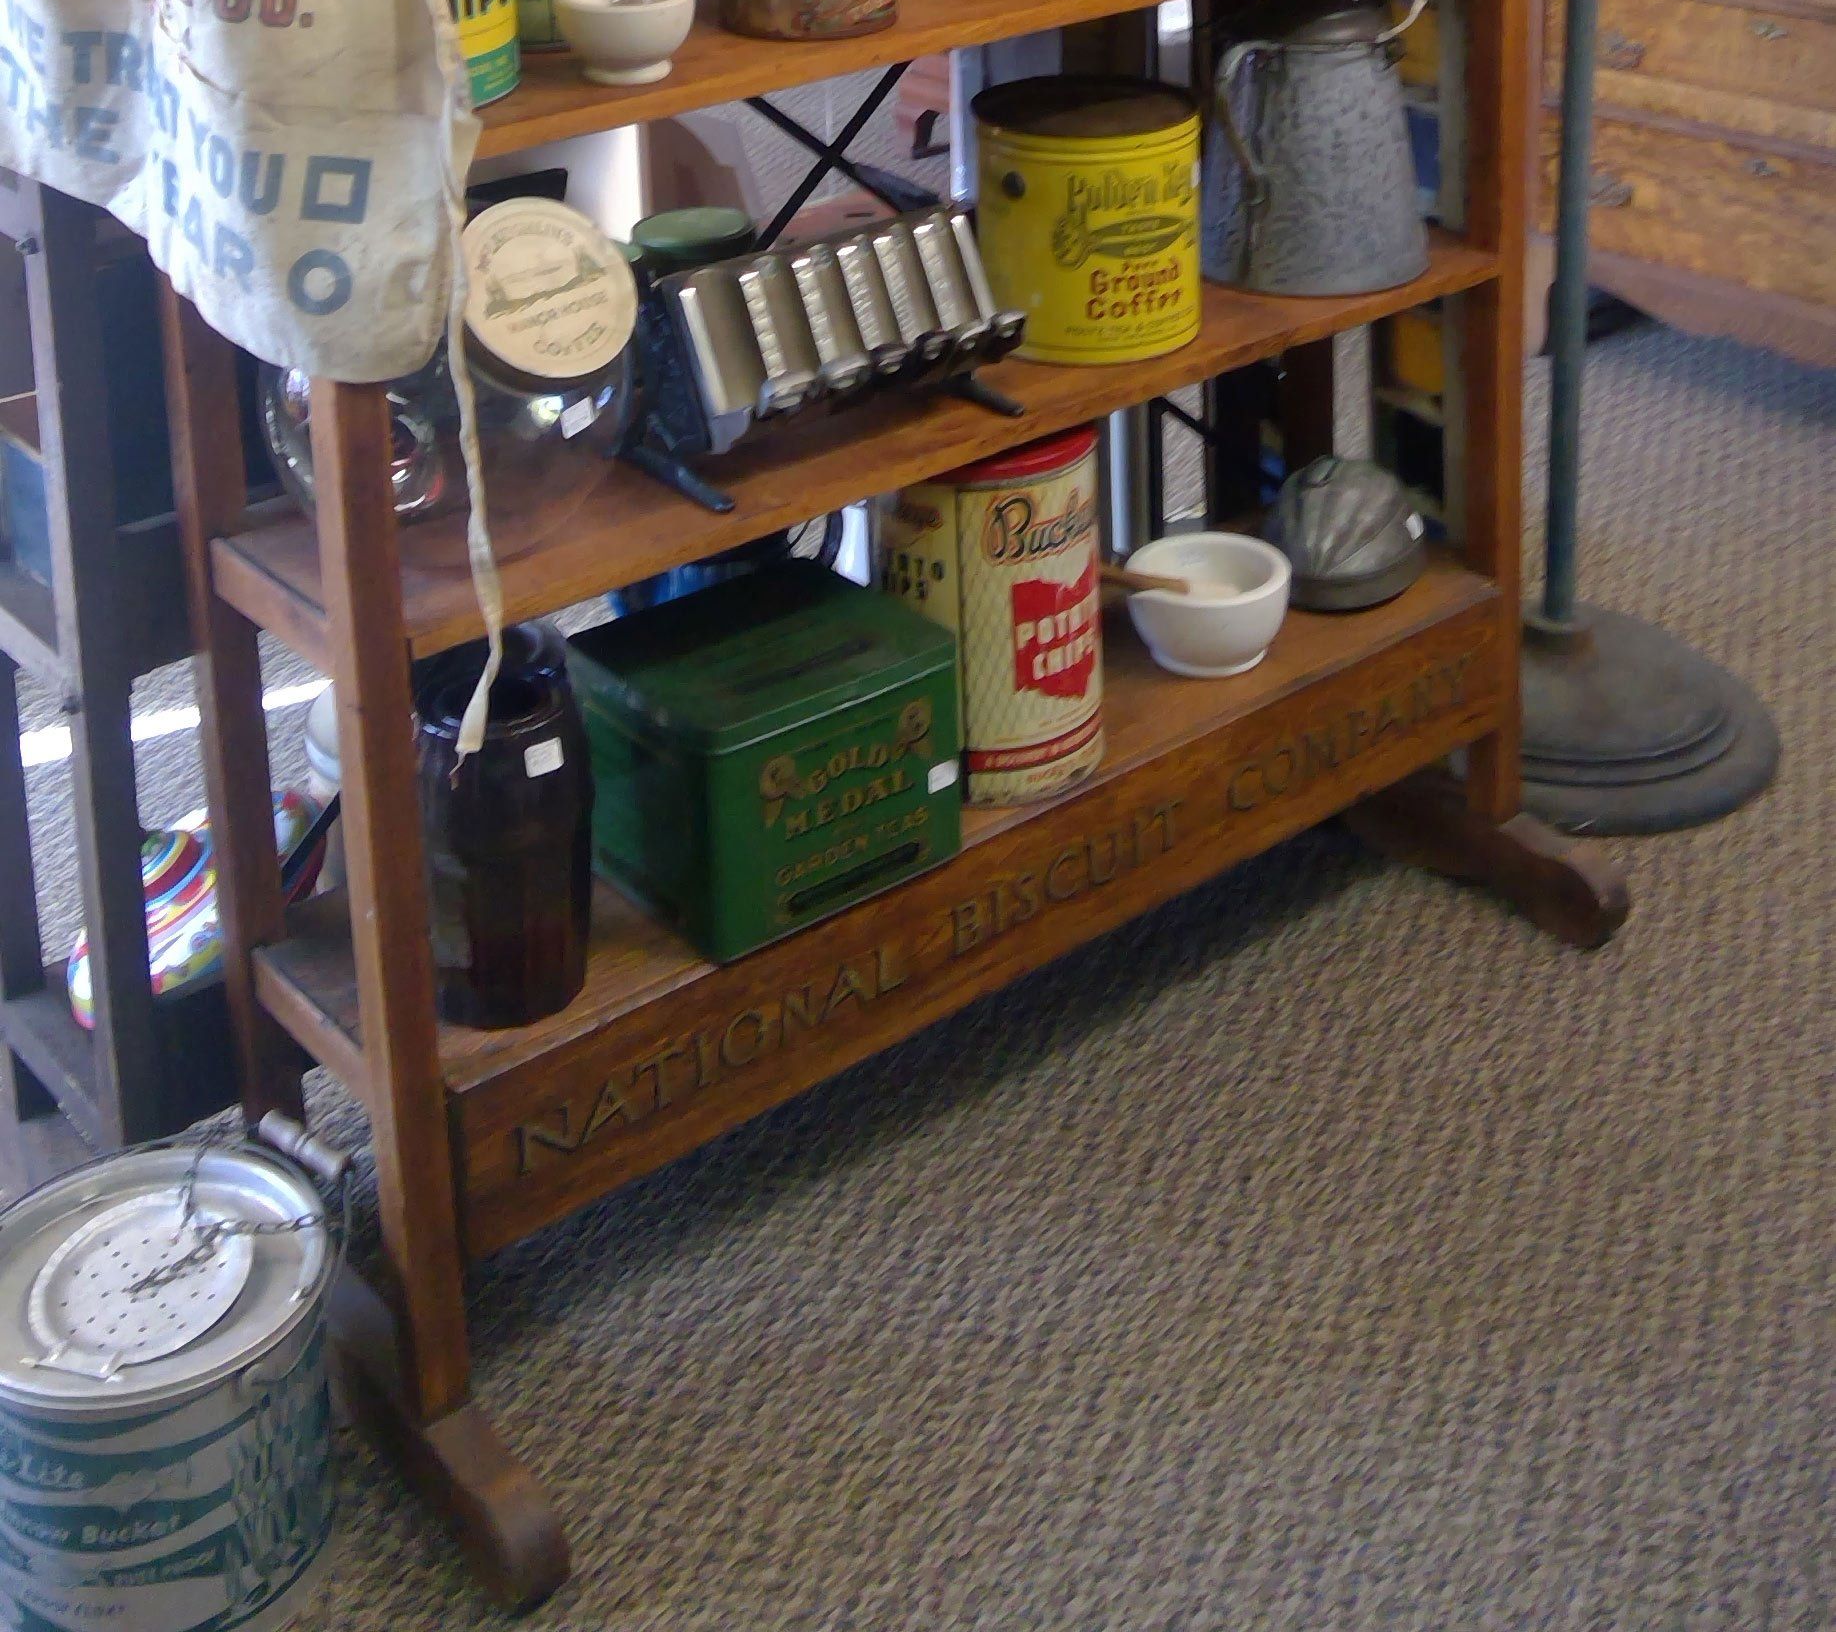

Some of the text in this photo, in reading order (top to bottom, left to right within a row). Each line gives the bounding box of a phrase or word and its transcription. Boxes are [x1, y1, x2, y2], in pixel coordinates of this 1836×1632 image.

[1089, 256, 1182, 296] Ground
[1086, 287, 1183, 321] Coffee
[807, 742, 890, 794] GOLD
[785, 768, 916, 842] MEDAL
[512, 653, 1475, 1175] NATIONAL BISCUIT COMPANY
